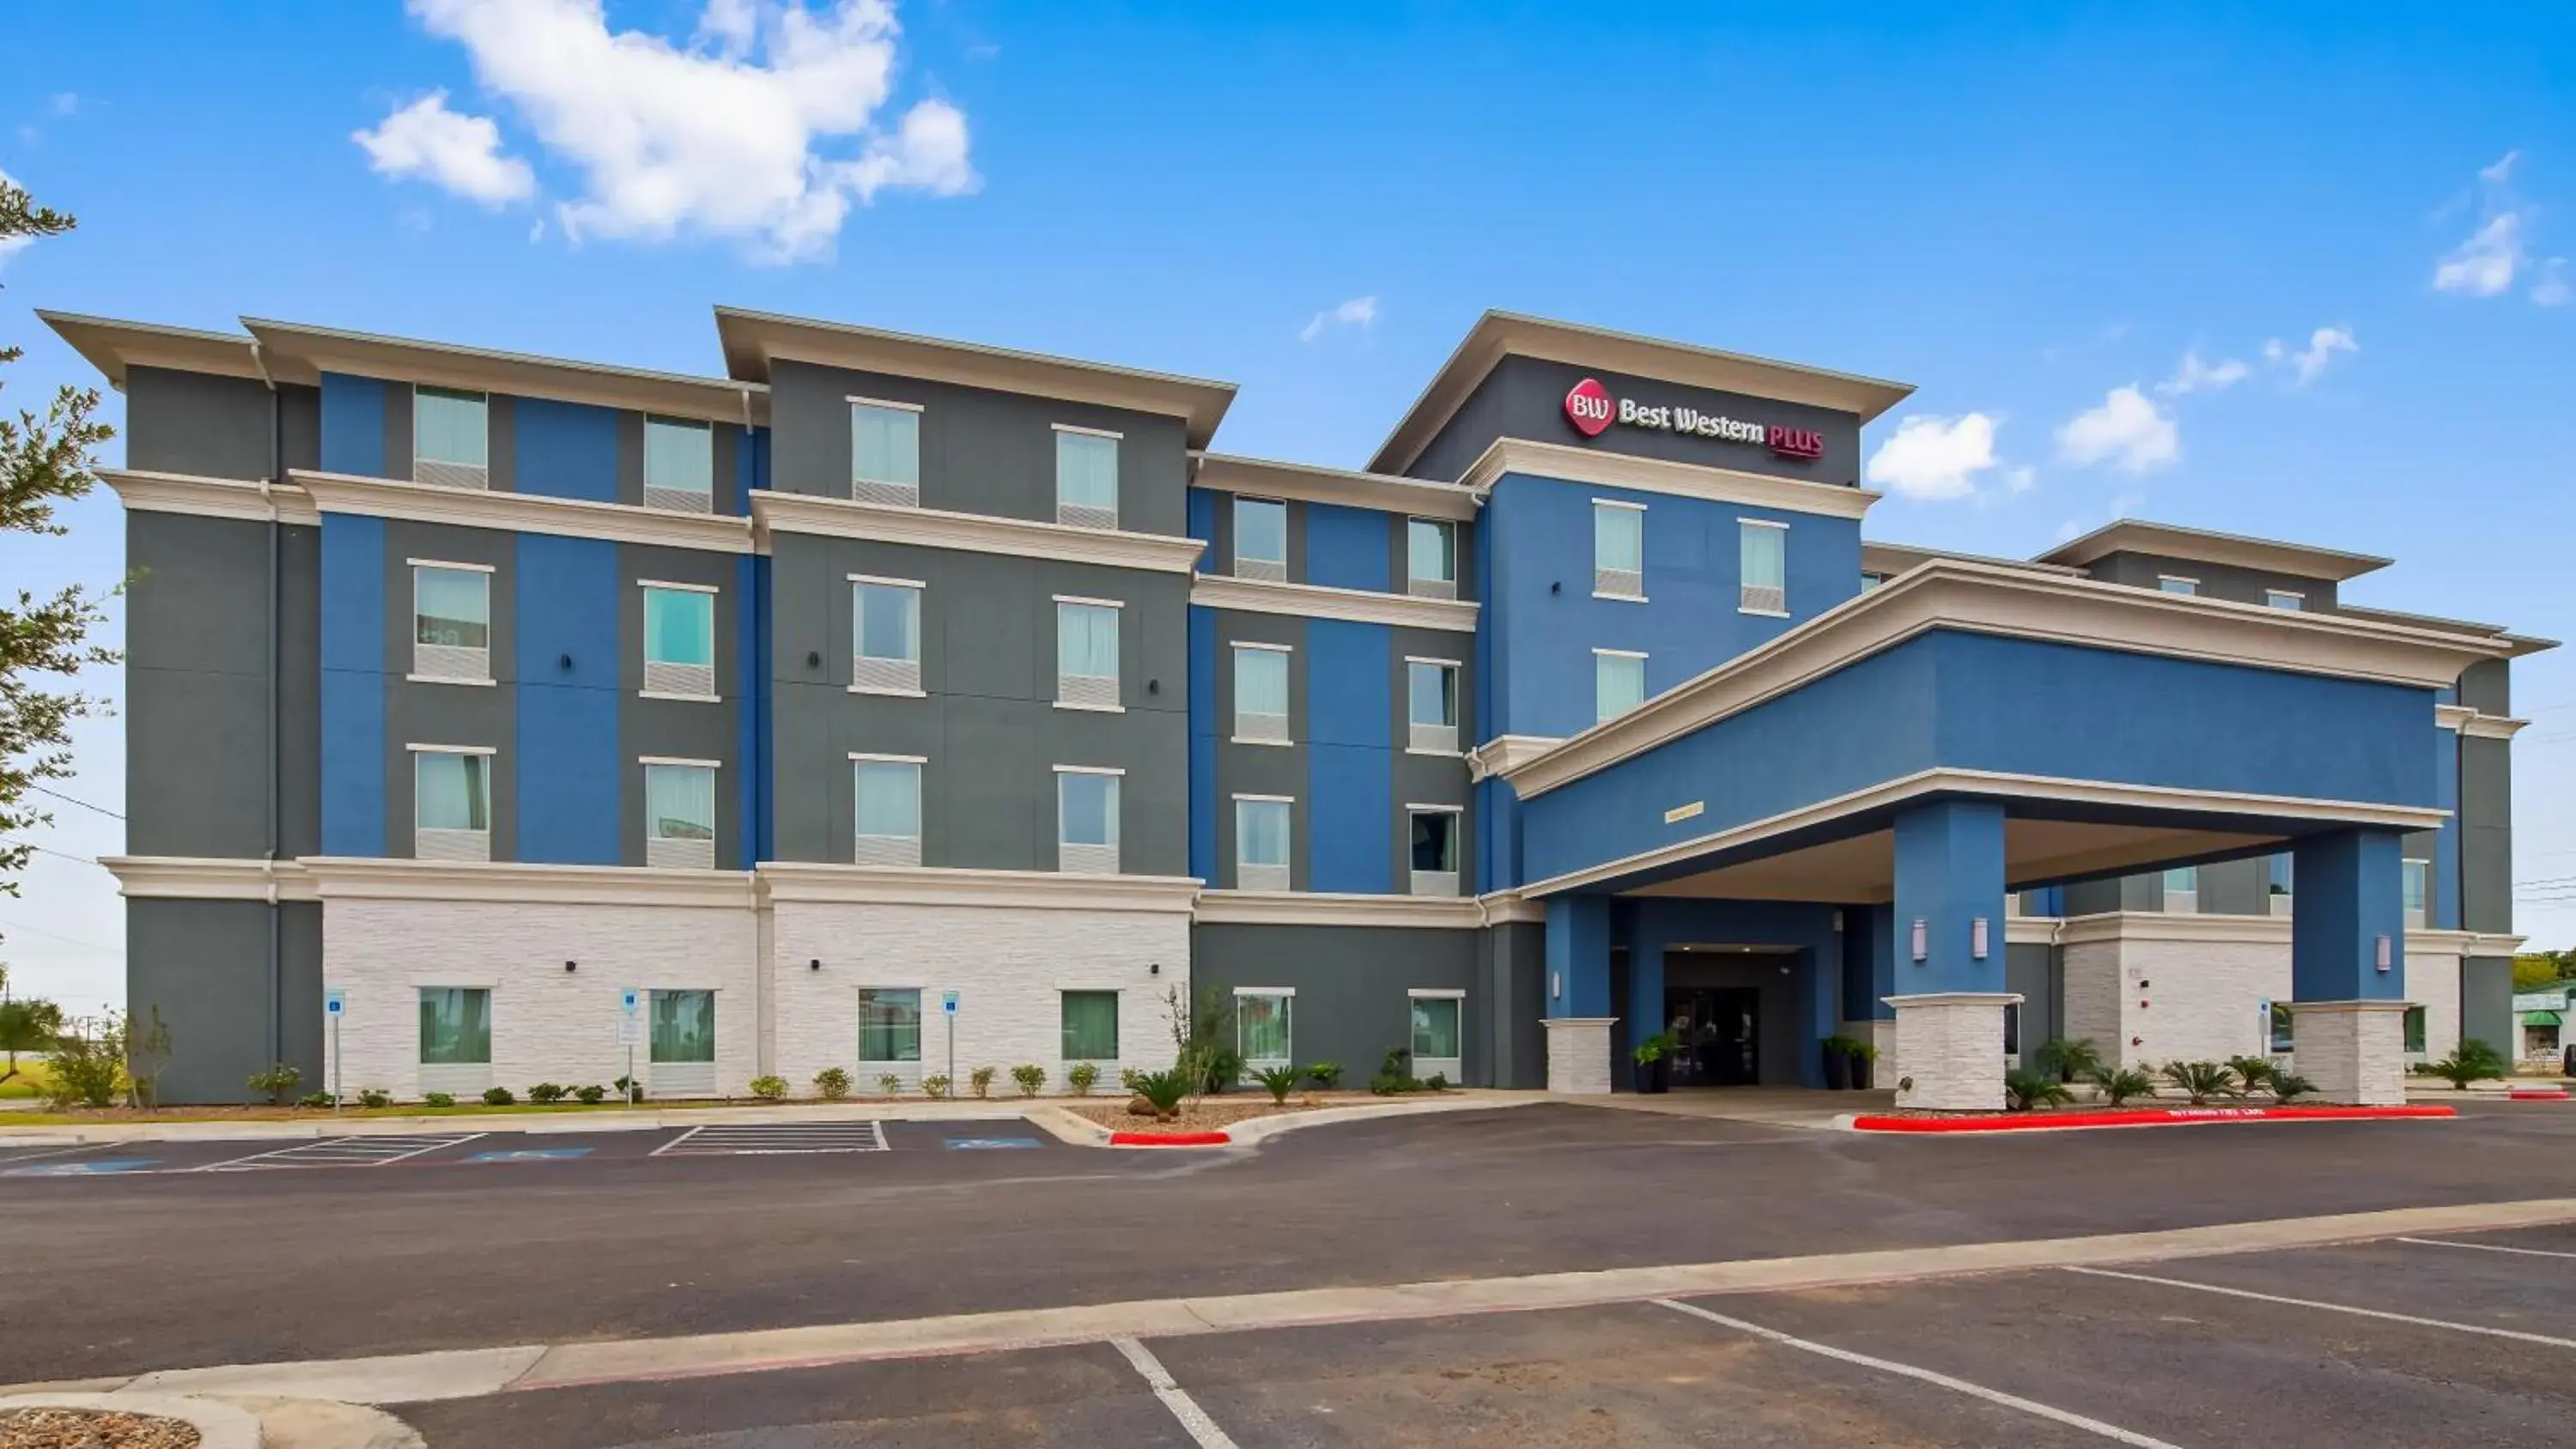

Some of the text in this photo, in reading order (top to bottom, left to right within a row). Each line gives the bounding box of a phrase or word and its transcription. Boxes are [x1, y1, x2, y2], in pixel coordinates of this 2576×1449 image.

[1573, 394, 1608, 420] BW
[1619, 398, 1825, 453] Best Western PLUS
